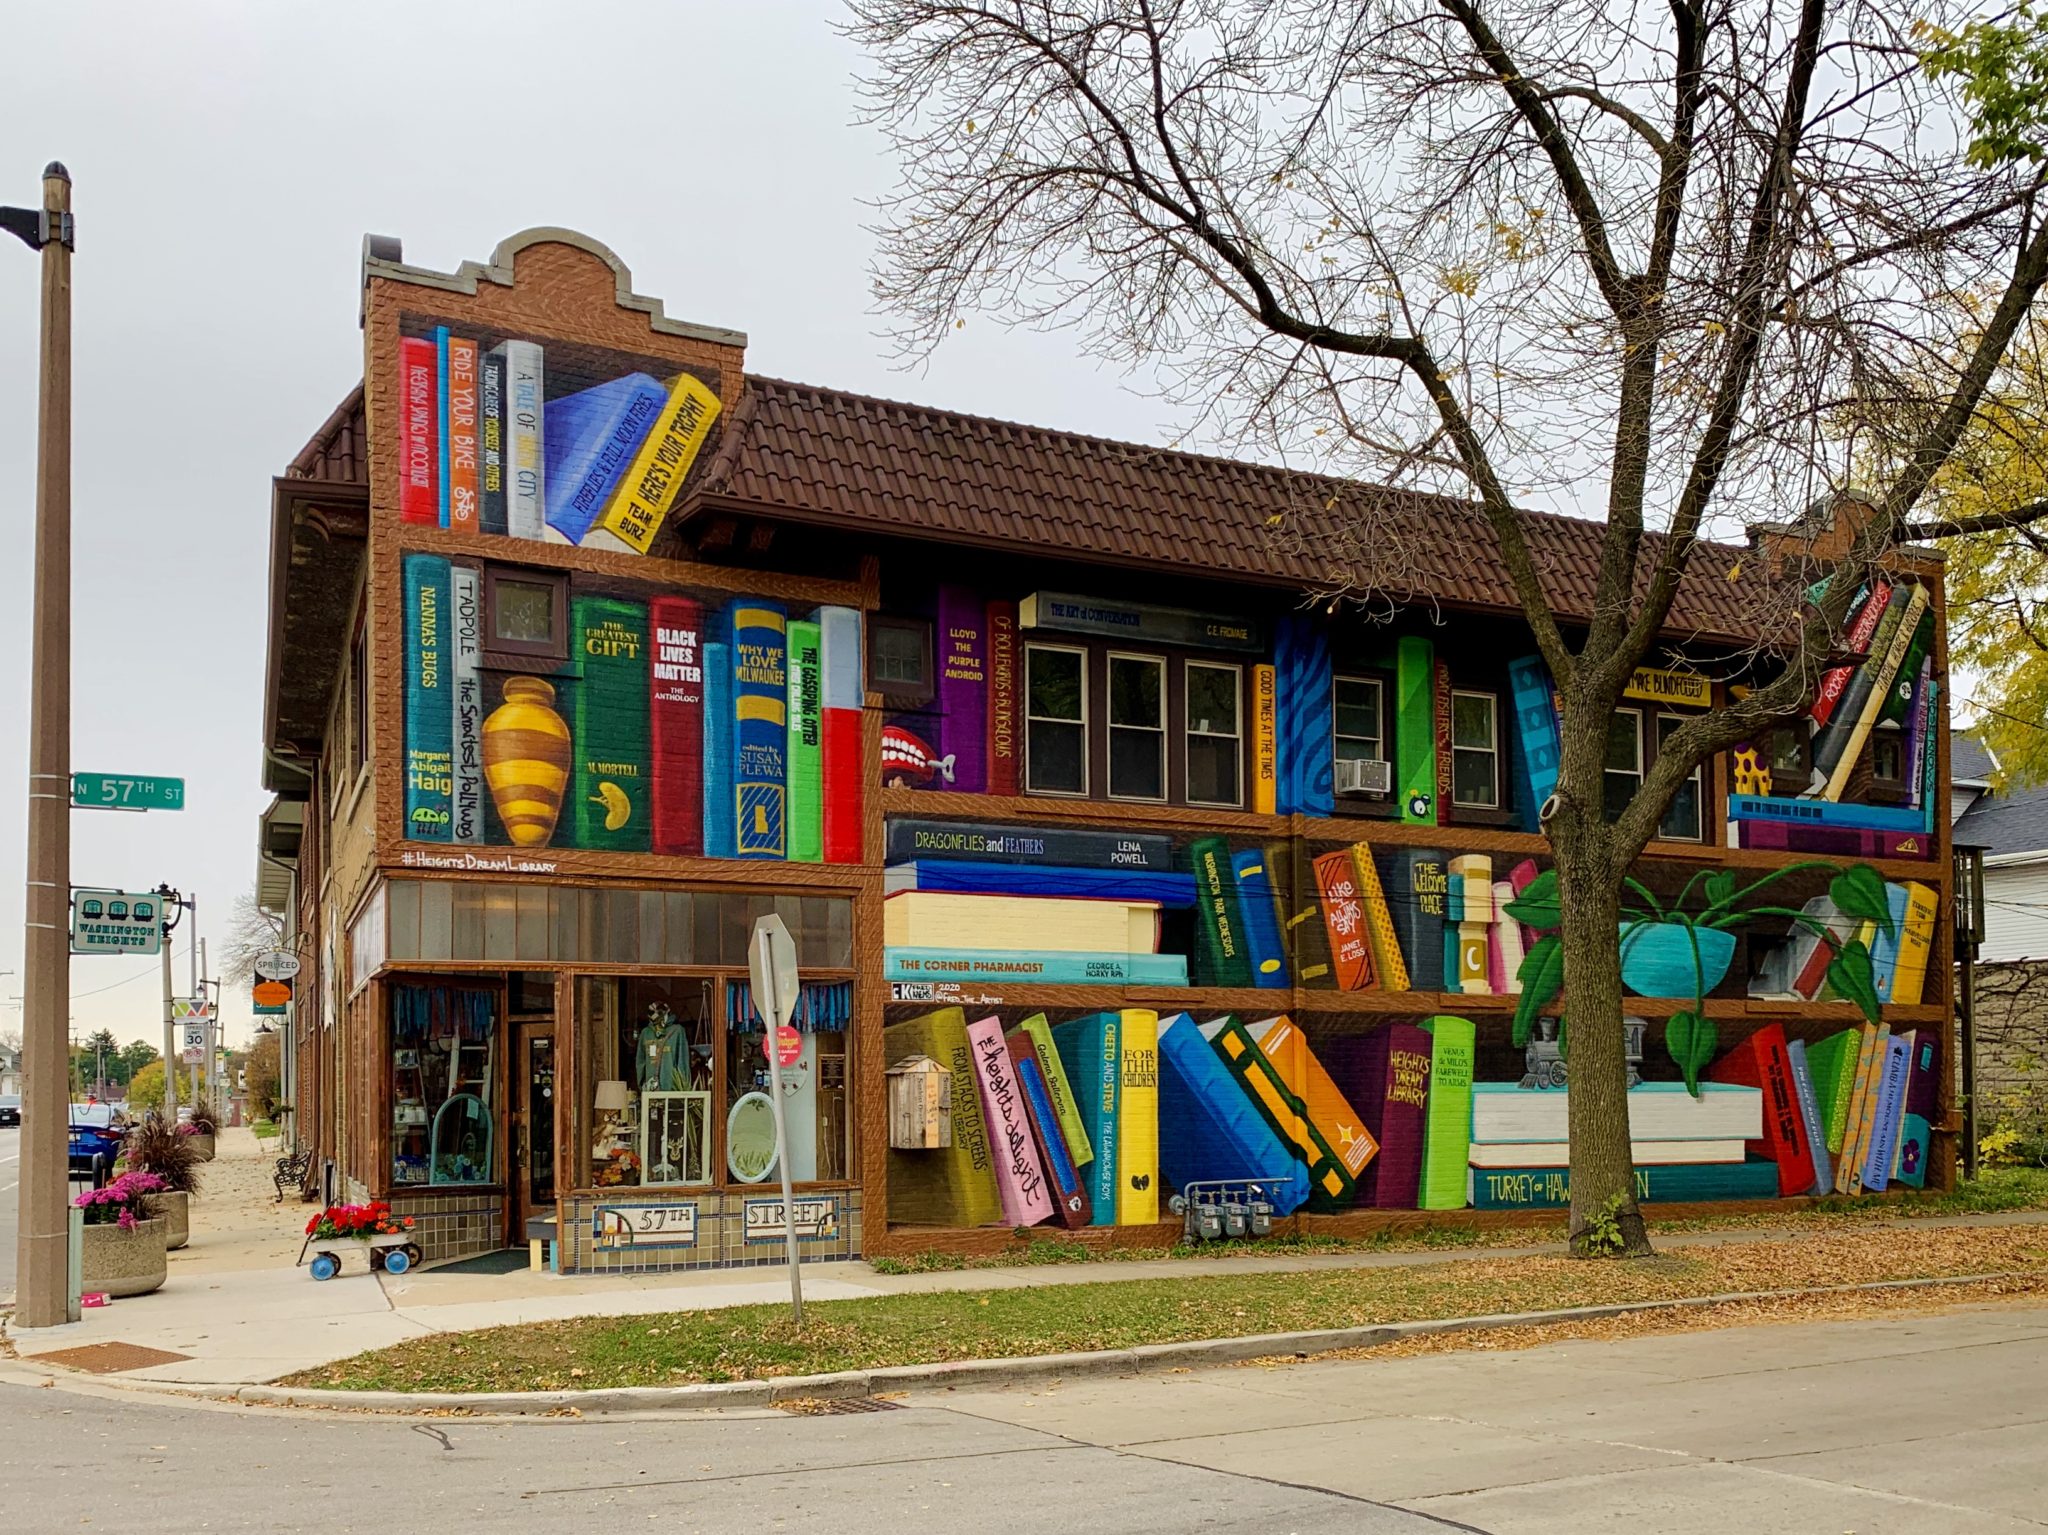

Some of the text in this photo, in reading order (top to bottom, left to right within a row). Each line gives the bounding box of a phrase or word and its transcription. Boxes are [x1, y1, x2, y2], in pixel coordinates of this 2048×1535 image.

[517, 372, 533, 381] A
[517, 384, 535, 410] TALE
[454, 347, 474, 470] RIDE YOUR BIKE
[484, 365, 500, 492] TAKING CARE OF YOURSELF AND OTHERS
[518, 413, 535, 430] OF
[572, 392, 654, 514] FIREFLIES & FULL MOON FIRES
[637, 392, 706, 507] HERE'S YOUR TROPHY
[519, 471, 536, 500] CITY
[628, 502, 654, 526] TEAM
[619, 517, 646, 541] BURZ
[994, 616, 1012, 630] OF
[1051, 603, 1064, 618] THE
[1066, 605, 1080, 620] ART
[1088, 608, 1140, 627] CONVERSATION
[602, 622, 624, 630] THE
[950, 628, 976, 640] LLOYD
[1219, 627, 1248, 640] FROMAGE
[421, 586, 437, 688] NANNA'S BUGS
[586, 629, 640, 643] GREATEST
[656, 628, 697, 648] BLACK
[586, 639, 640, 658] GIFT
[660, 646, 694, 664] LIVES
[737, 644, 784, 658] WHY WE
[955, 642, 972, 652] THE
[742, 656, 778, 670] LOVE
[948, 655, 980, 668] PURPLE
[994, 633, 1012, 690] BOULEVARDS
[654, 663, 701, 683] MATTER
[736, 668, 785, 687] MILWAUKEE
[945, 668, 984, 682] ANDROID
[654, 692, 700, 704] ANTHOLOGY
[670, 687, 685, 695] THE
[802, 648, 818, 746] THE GOSSIPING OTTER
[456, 581, 478, 838] TADPOLE the Smartest Pollywog
[1260, 670, 1272, 780] GOOD TIMES AT THE TIMES
[410, 750, 451, 763] Margaret
[739, 752, 782, 765] SUSAN
[742, 744, 778, 756] edited by
[409, 760, 452, 773] Abigail
[601, 763, 639, 777] MORTELL
[739, 764, 783, 777] PLEWA
[1438, 751, 1452, 796] FRIENDS
[1926, 740, 1936, 794] KNOWS
[78, 780, 182, 802] N 57TH ST
[408, 773, 452, 796] Haig
[916, 831, 1044, 856] DRAGONFLIES and FEATHERS
[1117, 840, 1142, 853] LENA
[1110, 852, 1148, 865] POWELL
[1416, 862, 1440, 874] THE
[1413, 874, 1447, 894] WELCOME
[1204, 852, 1235, 958] WASHINGTON PARK WEDNESDAYS
[1420, 894, 1444, 916] PLACE
[80, 924, 155, 936] WASHINGTON
[1337, 918, 1356, 936] SAY
[87, 934, 146, 946] HEIGHTS
[1341, 940, 1361, 953] JANET
[1340, 947, 1366, 962] E. LOSS
[257, 960, 298, 969] SPRUCED
[900, 960, 1044, 973] THE CORNER PHARMACIST
[1086, 962, 1112, 970] GEORGE
[1086, 970, 1108, 978] HORKY
[938, 984, 960, 992] 2020
[186, 1036, 202, 1044] 30
[1104, 1024, 1116, 1061] CHEETO
[952, 1046, 968, 1076] FROM
[1037, 1043, 1052, 1076] Galena
[1124, 1050, 1154, 1060] FOR
[1443, 1048, 1465, 1056] VENUS
[1124, 1060, 1155, 1072] THE
[1390, 1050, 1431, 1074] HEIGHTS
[1889, 1055, 1905, 1083] CLIMB
[1103, 1063, 1114, 1082] AND
[1122, 1073, 1156, 1088] CHILDREN
[1394, 1070, 1424, 1088] DREAM
[1436, 1068, 1468, 1077] FAREWELL
[1439, 1077, 1467, 1086] TO ARMS
[957, 1075, 977, 1112] STACKS
[1388, 1084, 1428, 1110] LIBRARY
[964, 1112, 980, 1128] TO
[977, 1036, 1040, 1208] THE heights delight
[1878, 1100, 1893, 1150] MOUNTAIN
[953, 1113, 969, 1152] LIBRARY
[1101, 1121, 1113, 1200] THE LAWNMOWER BOYS
[1875, 1150, 1887, 1172] WITH
[1486, 1174, 1536, 1203] TURKEY
[1851, 1172, 1861, 1187] 2
[640, 1204, 823, 1230] 57TH STREET
